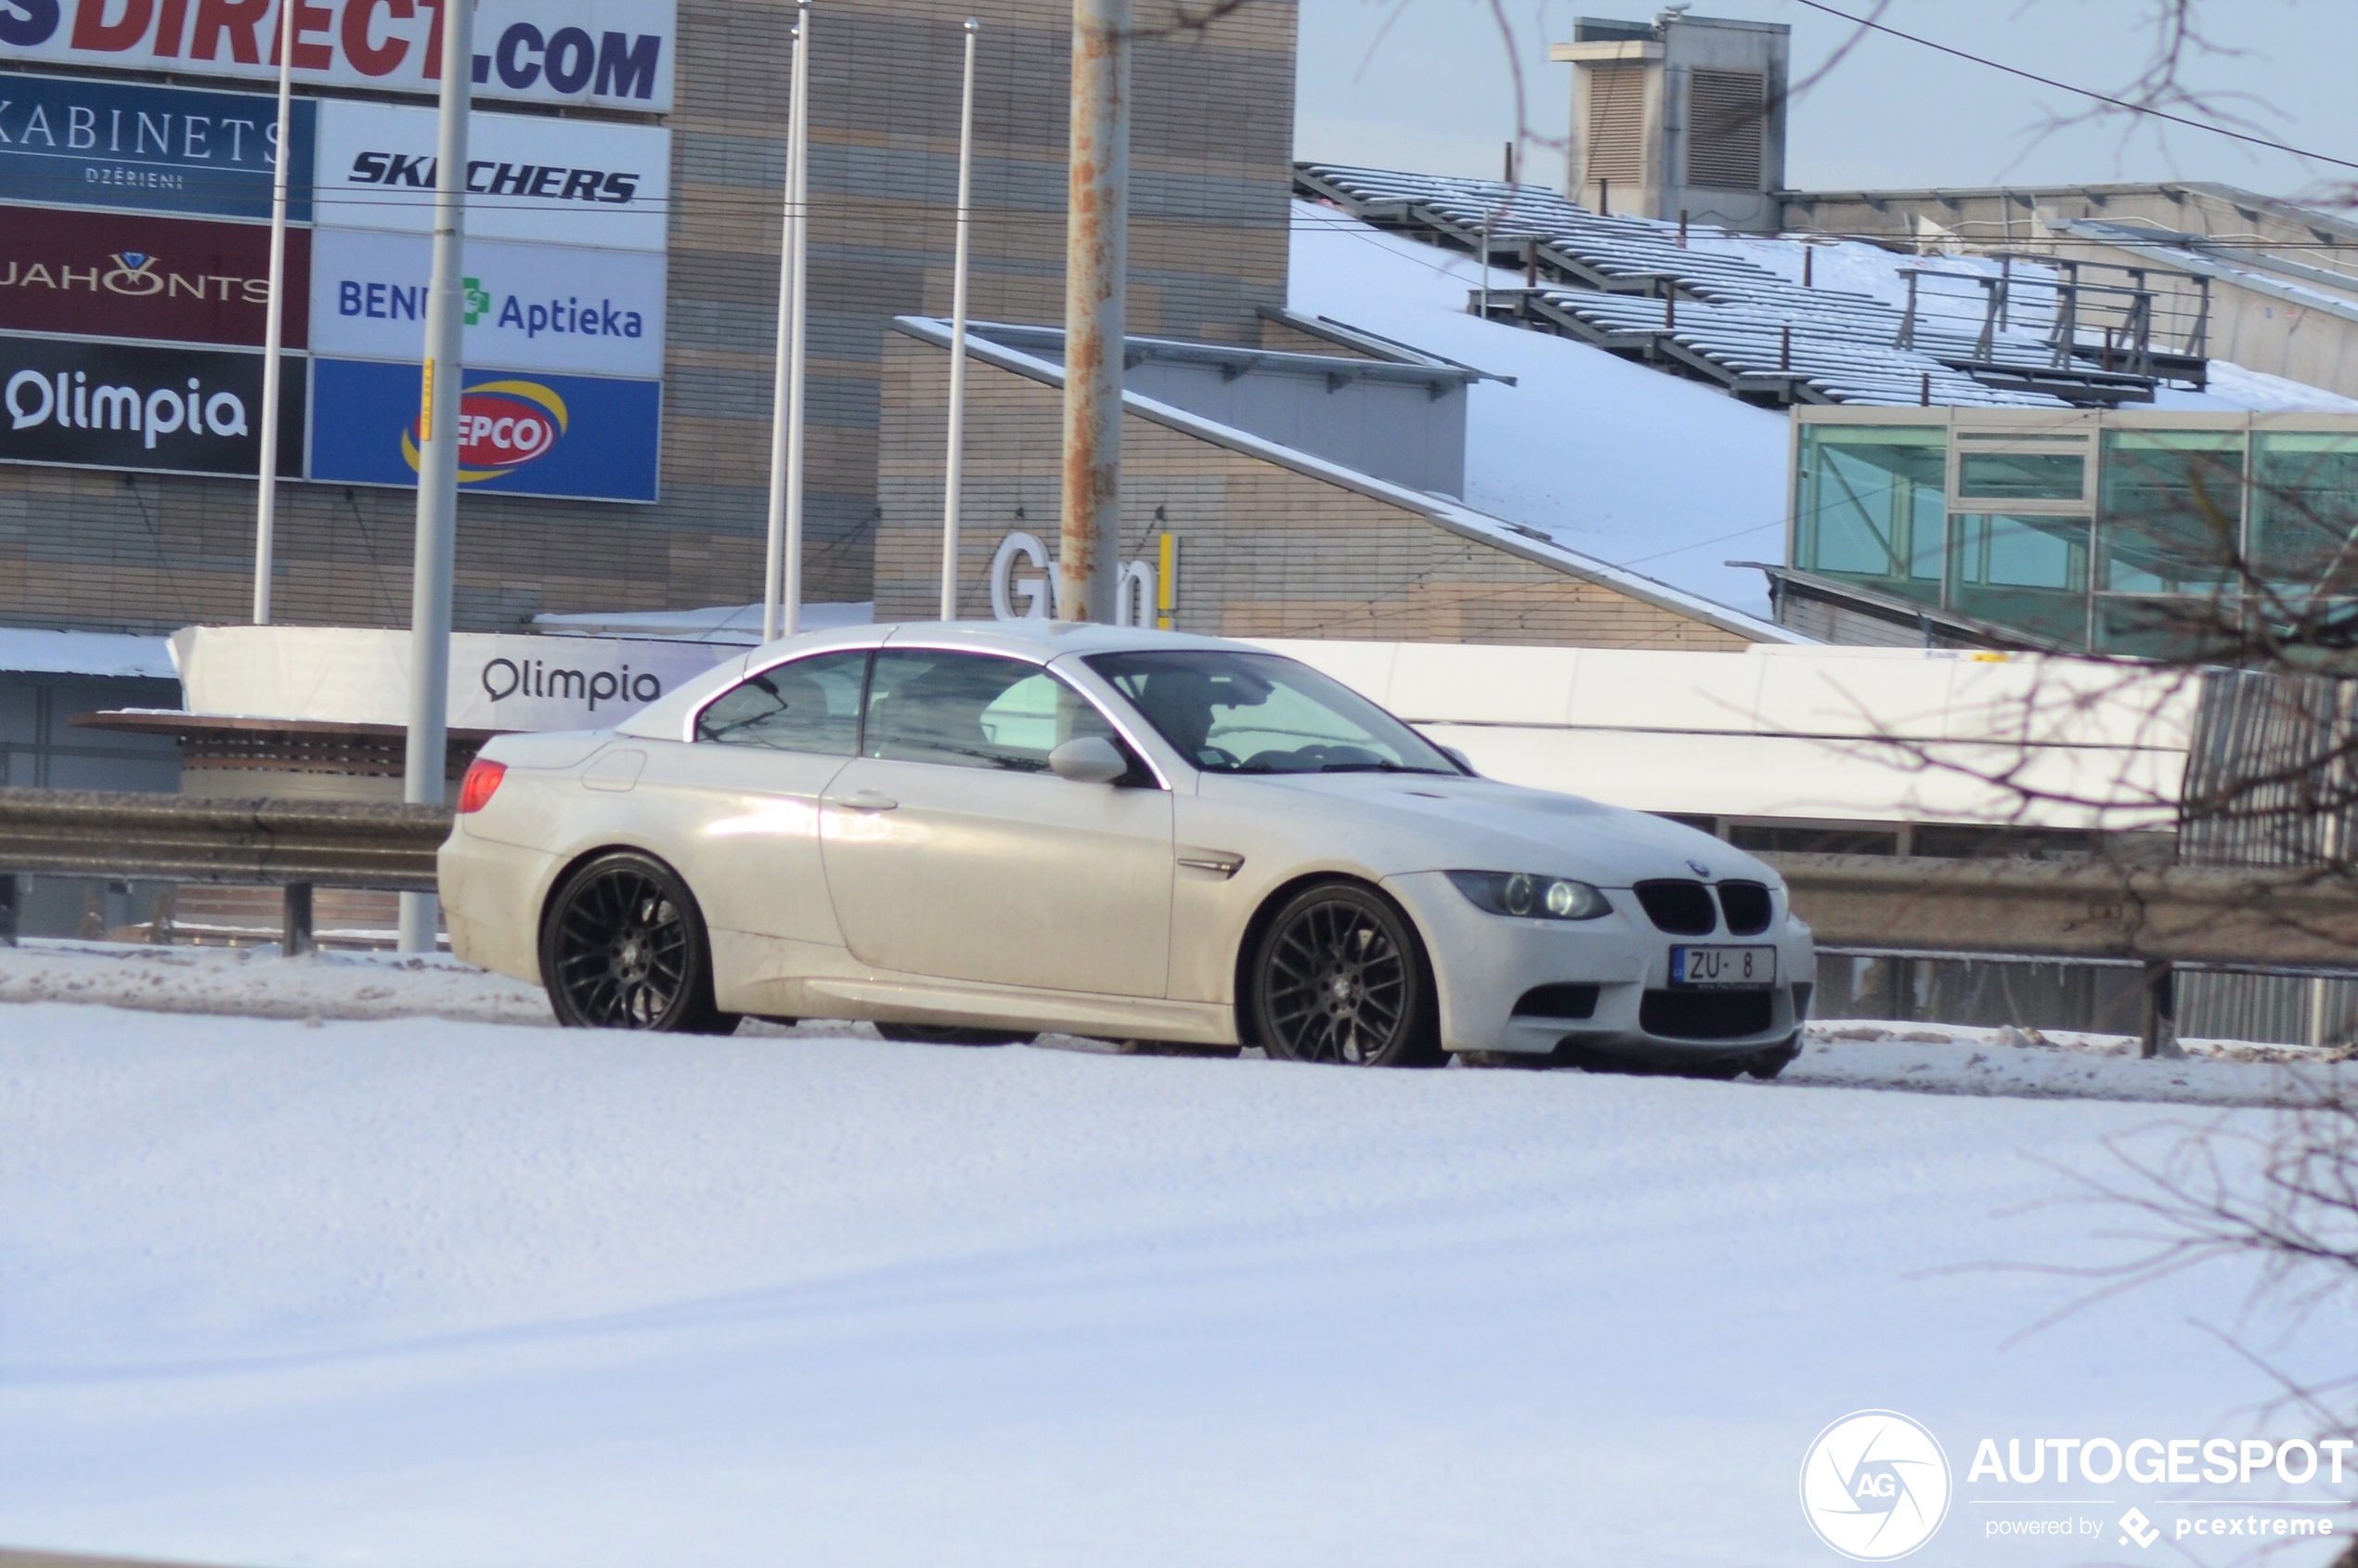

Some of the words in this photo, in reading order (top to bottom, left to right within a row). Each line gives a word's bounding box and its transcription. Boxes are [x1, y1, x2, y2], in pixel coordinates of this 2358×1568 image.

[348, 150, 641, 203] SKCHERS
[339, 280, 430, 321] BEN
[498, 294, 643, 339] Aptieka
[5, 369, 248, 449] Olimpia
[458, 414, 542, 451] EPCO
[483, 657, 661, 712] Olimpia
